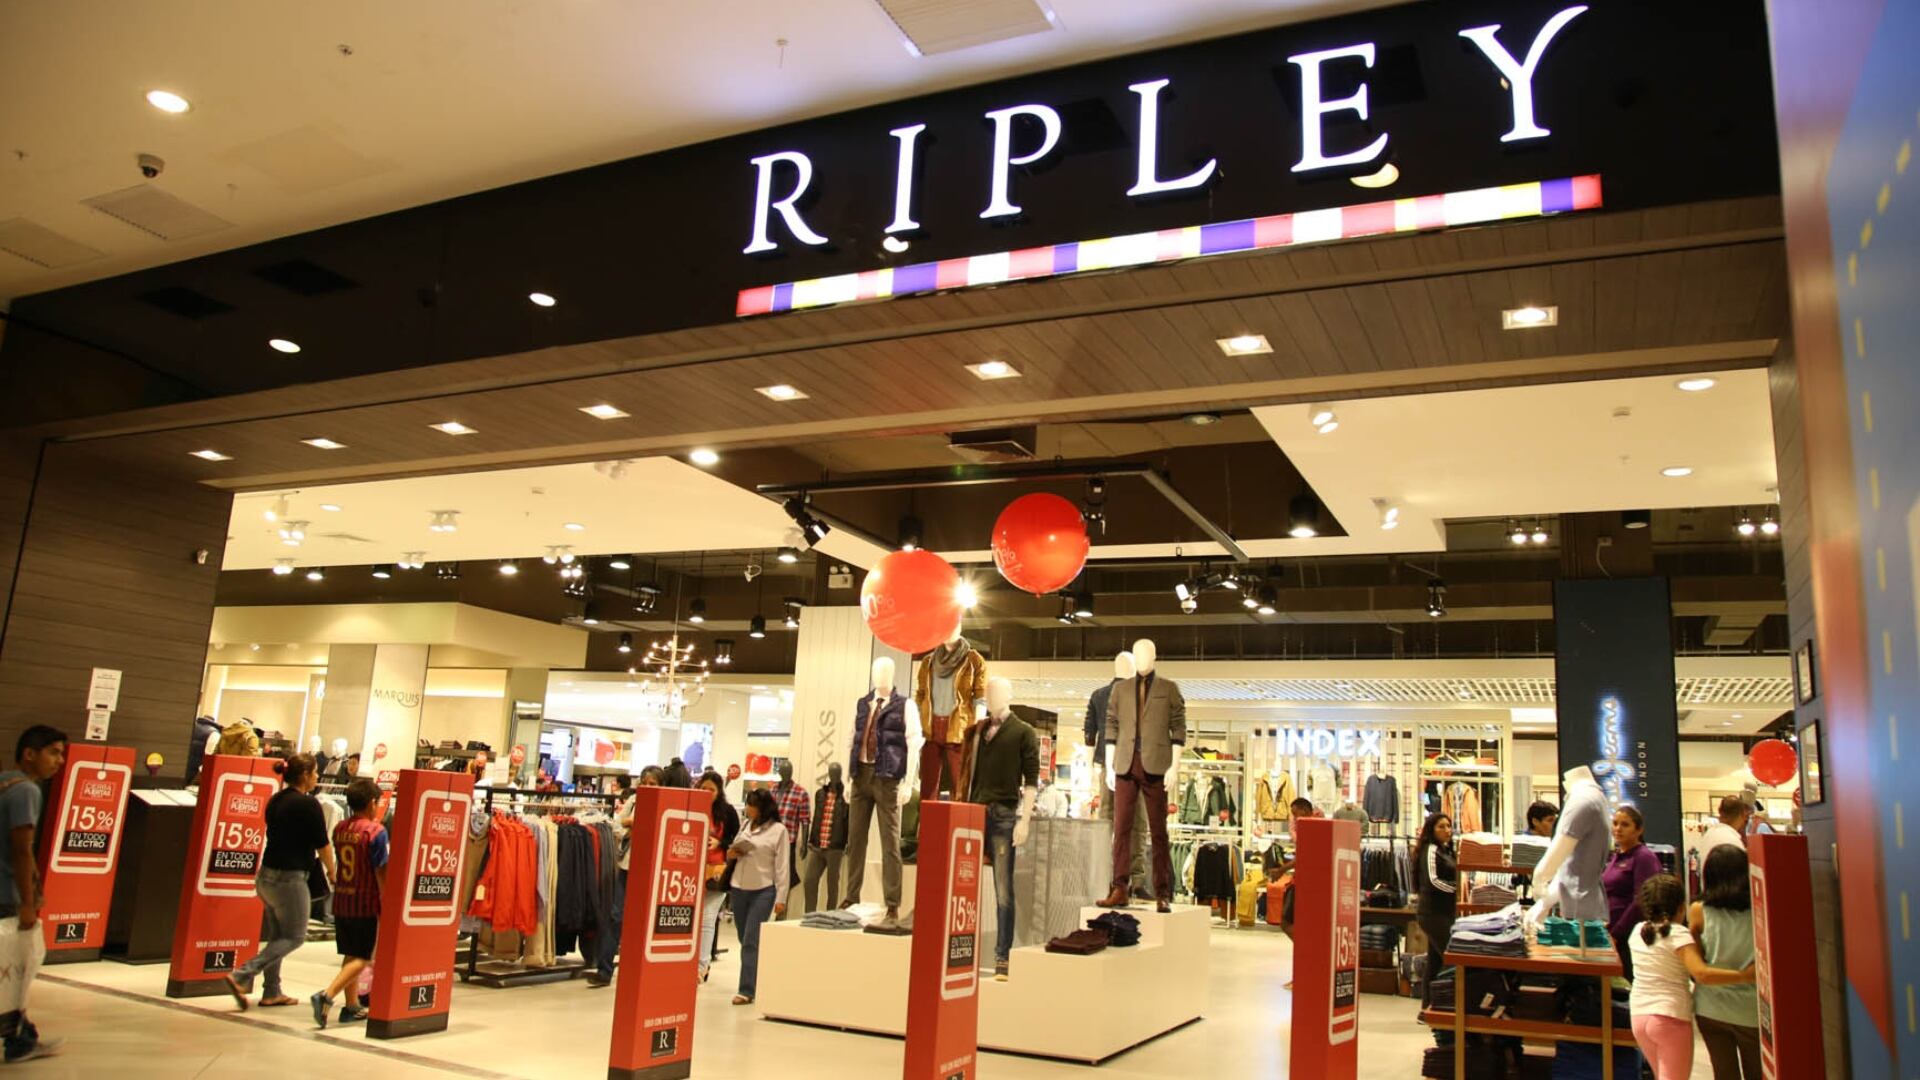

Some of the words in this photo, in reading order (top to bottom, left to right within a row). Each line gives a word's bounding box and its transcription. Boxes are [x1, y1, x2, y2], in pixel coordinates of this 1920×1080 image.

[743, 5, 1589, 255] RIPLEY
[373, 689, 419, 708] MARQUIS
[1277, 728, 1380, 757] INDEX
[1638, 741, 1648, 798] LONDON
[71, 805, 114, 830] 15%
[70, 832, 81, 840] EN
[83, 833, 107, 841] TODO
[217, 822, 262, 849] 15%
[67, 840, 105, 849] ELECTRO
[214, 860, 254, 869] ELECTRO
[216, 852, 228, 860] EN
[230, 852, 255, 861] TODO
[341, 845, 355, 881] 9
[420, 844, 457, 873] 15%
[420, 876, 430, 885] EN
[431, 876, 452, 885] TODO
[661, 870, 697, 903] 15%
[418, 885, 451, 894] ELECTRO
[660, 906, 671, 916] EN
[671, 906, 691, 917] TODO
[952, 896, 976, 932] 15%
[65, 923, 77, 938] R
[659, 917, 690, 927] ELECTRO
[214, 952, 227, 967] R
[950, 947, 972, 959] ELECTRO
[417, 986, 428, 1003] R
[659, 1030, 669, 1049] R
